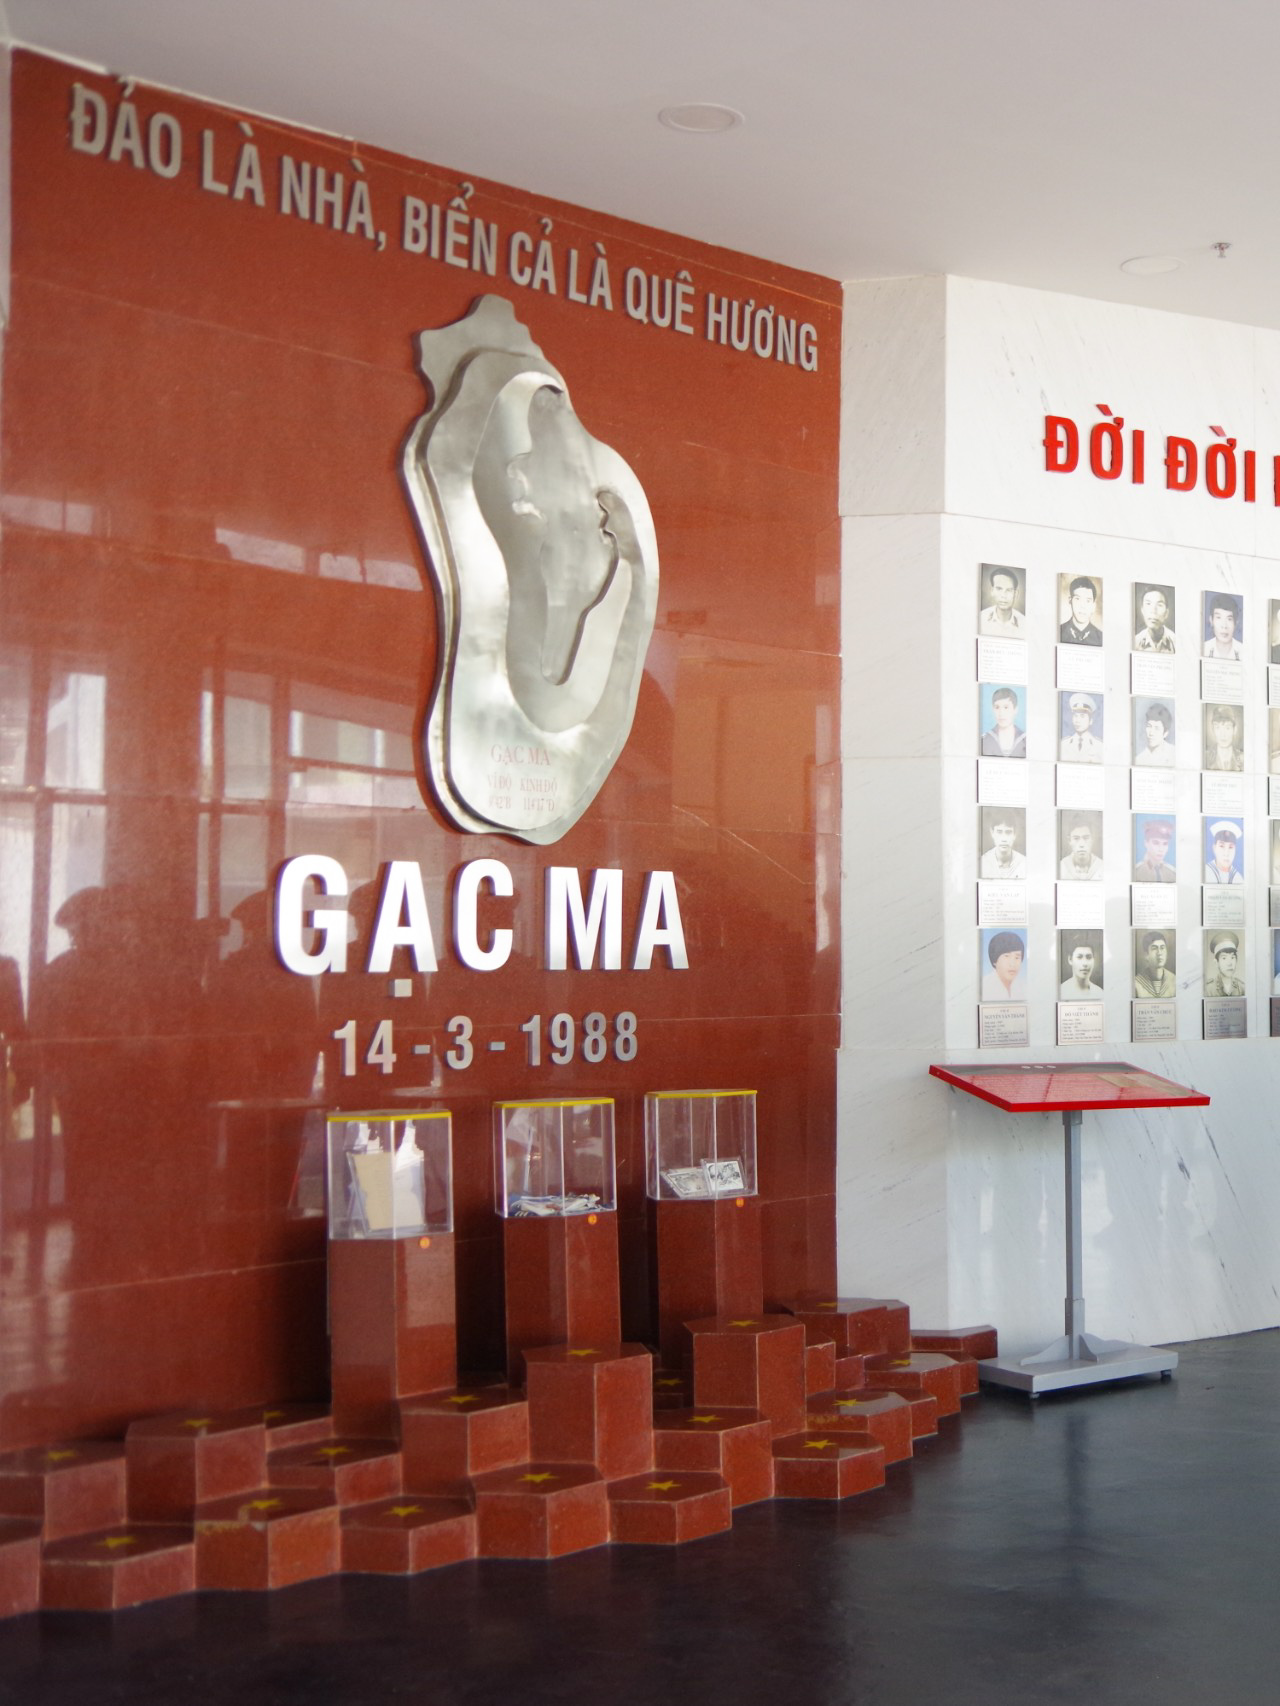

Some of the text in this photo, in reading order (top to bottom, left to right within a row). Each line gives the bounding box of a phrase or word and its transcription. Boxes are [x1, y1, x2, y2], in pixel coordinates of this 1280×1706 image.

[69, 76, 820, 373] ĐẢO LÀ NHÀ, BIỂN CẢ LÀ QUÊ HƯƠNG
[1043, 403, 1145, 485] ĐỜI
[1164, 425, 1256, 504] ĐỜI
[491, 743, 551, 766] GẠC MA
[275, 853, 690, 998] GẠC MA
